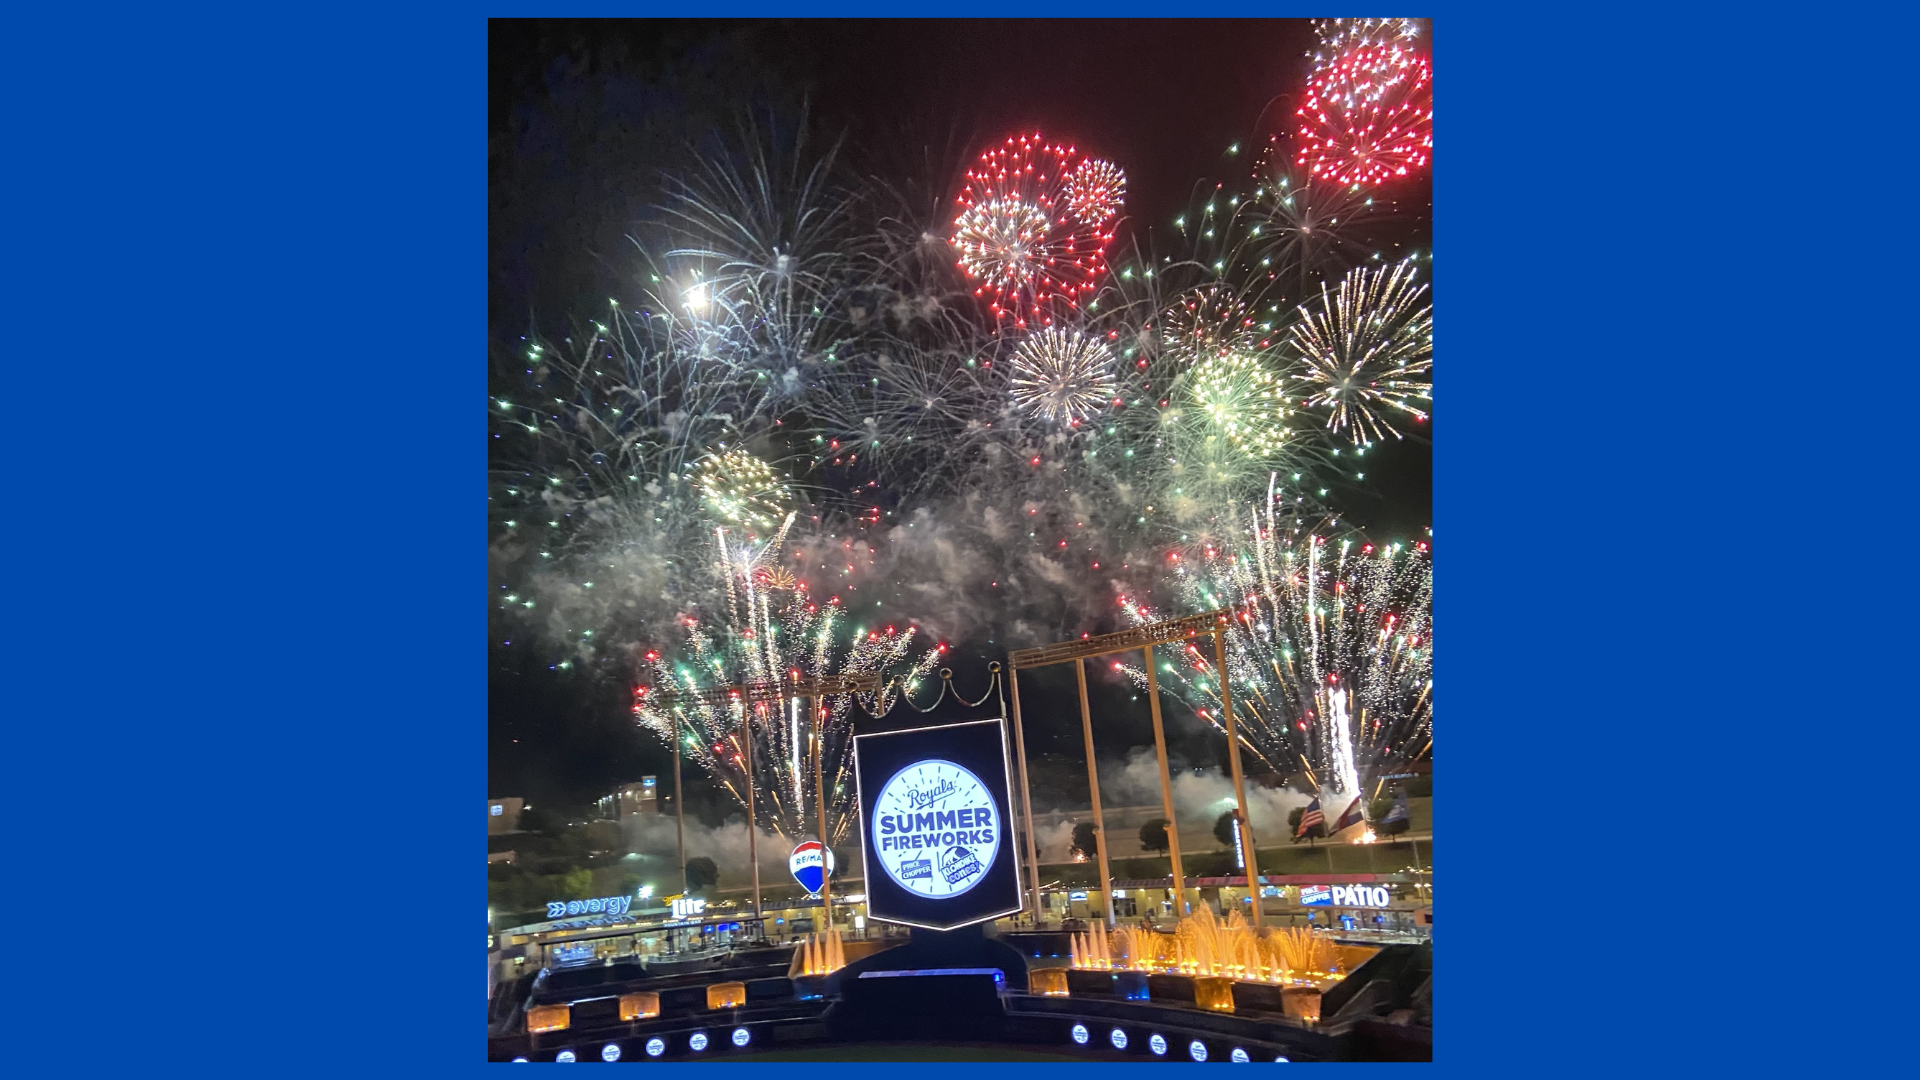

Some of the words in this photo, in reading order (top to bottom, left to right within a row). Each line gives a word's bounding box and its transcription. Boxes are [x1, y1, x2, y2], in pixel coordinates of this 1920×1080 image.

[907, 779, 955, 809] Royals
[881, 807, 993, 835] SUMMER
[882, 829, 995, 852] FIREWORKS
[796, 855, 823, 866] RE/MA
[902, 860, 920, 871] PRICE
[942, 853, 976, 879] KLONDIKE
[902, 865, 932, 879] CHOPPER
[567, 895, 632, 915] evergy
[1331, 886, 1390, 908] PATIO
[671, 898, 706, 920] Lite
